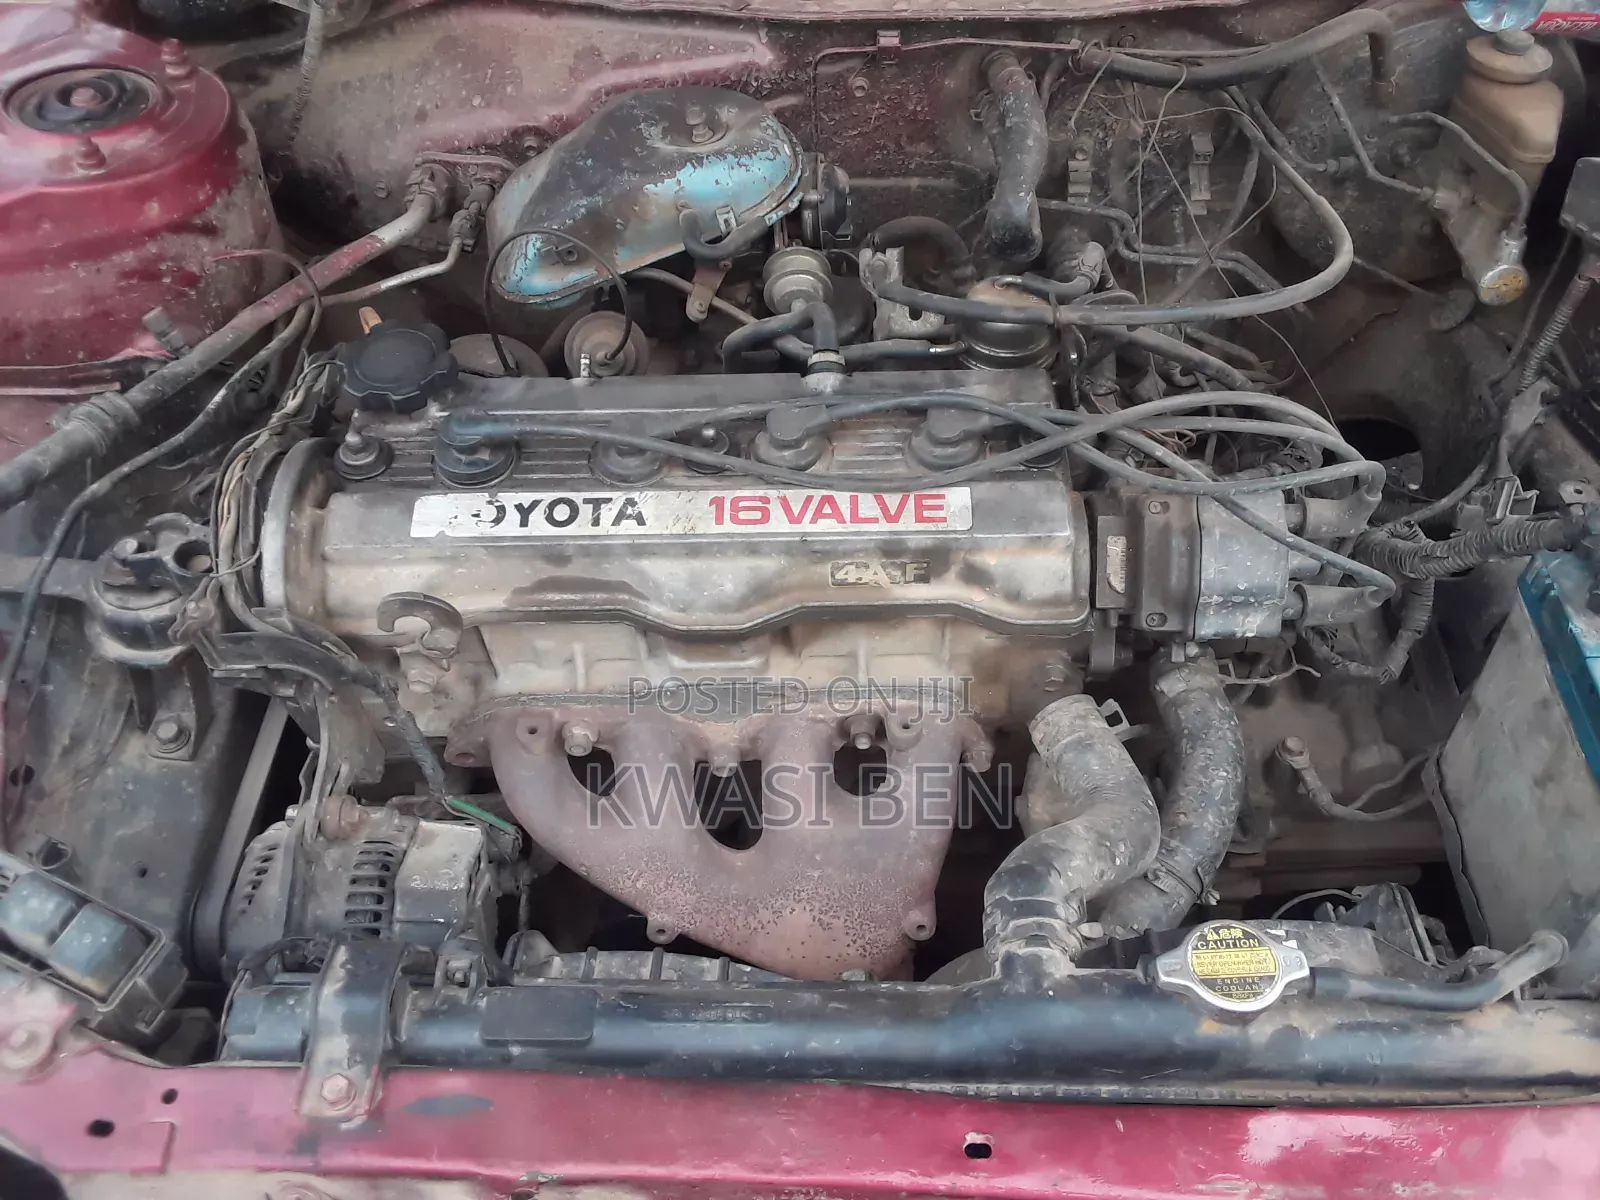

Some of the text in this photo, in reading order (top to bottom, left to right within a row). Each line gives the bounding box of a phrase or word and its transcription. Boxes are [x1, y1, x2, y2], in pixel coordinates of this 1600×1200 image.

[468, 497, 647, 528] OYOTA
[1219, 928, 1244, 939] 危険
[1197, 938, 1260, 950] CAUTION
[1216, 976, 1261, 985] ENGINE
